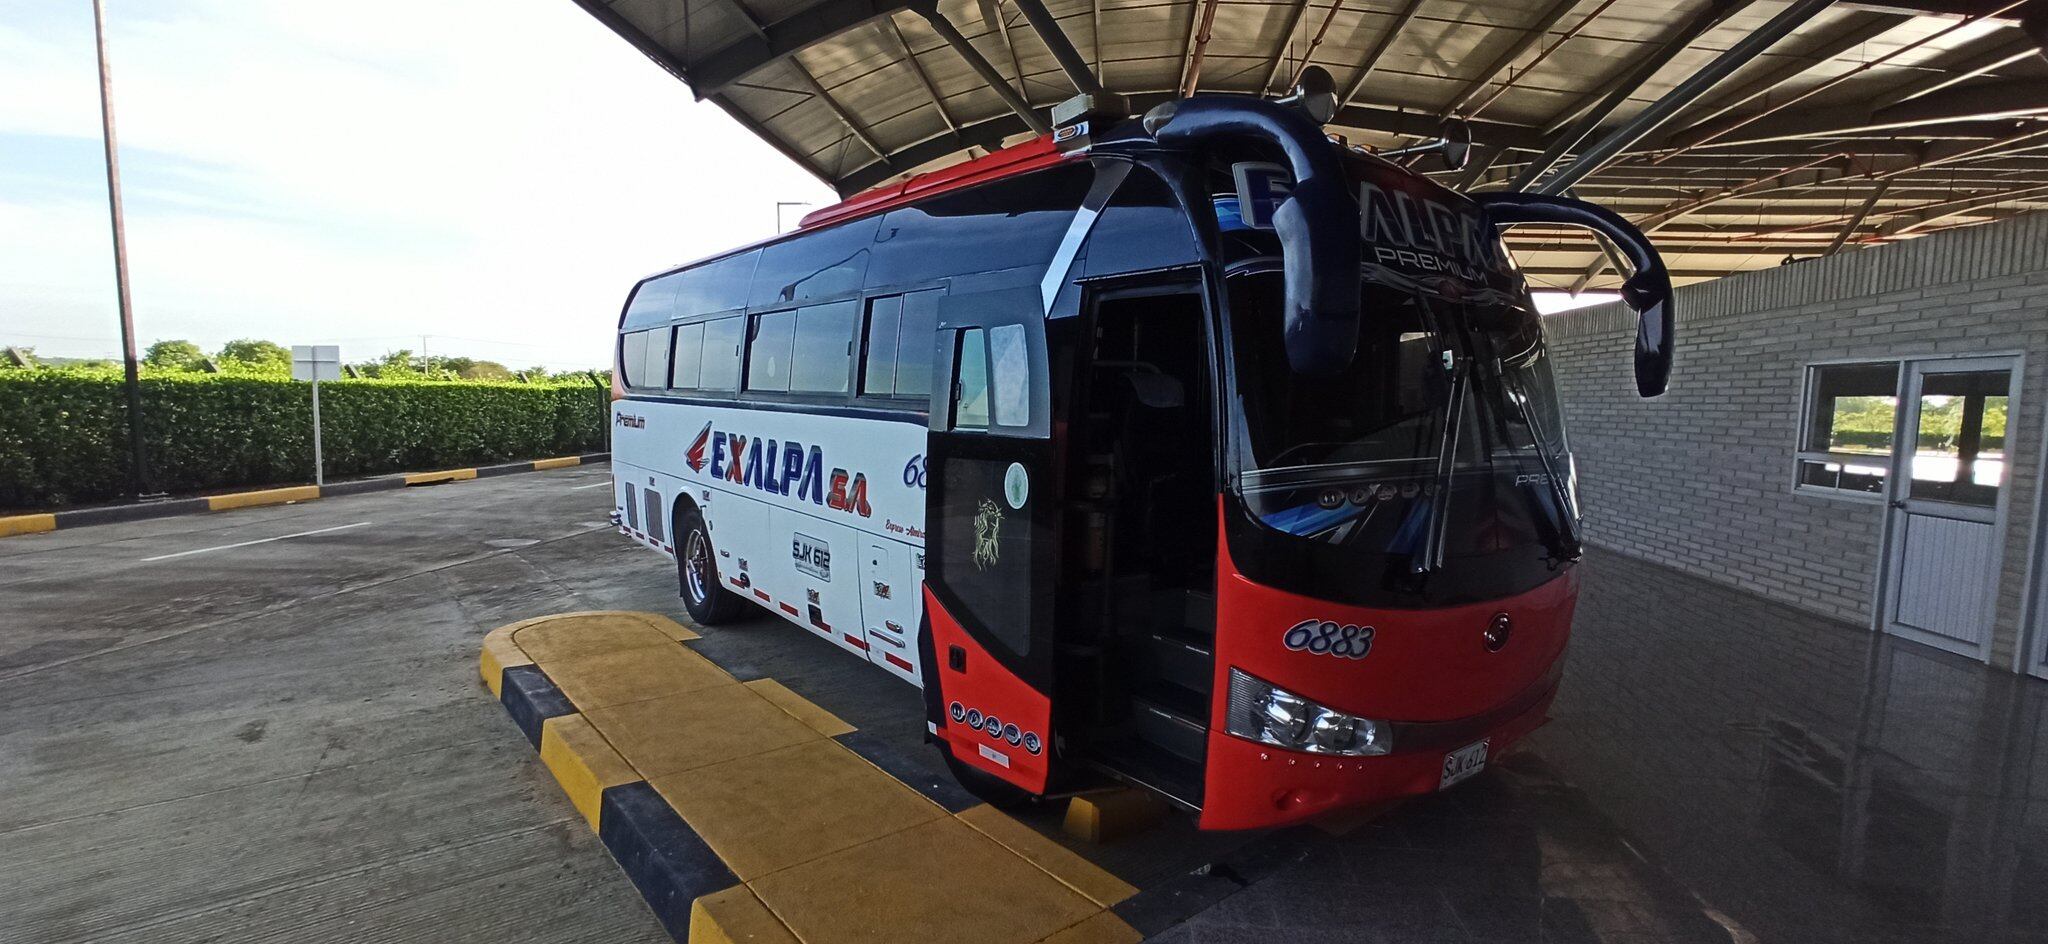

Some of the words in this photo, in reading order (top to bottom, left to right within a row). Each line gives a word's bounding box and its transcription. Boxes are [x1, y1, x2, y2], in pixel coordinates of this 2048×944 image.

[1231, 161, 1494, 273] EALPA
[1375, 246, 1488, 285] PREMIUM
[615, 411, 646, 430] Premium
[711, 431, 823, 504] EXALPA
[904, 454, 928, 489] 68
[792, 540, 812, 564] SJK
[814, 548, 831, 571] 612
[1284, 619, 1376, 660] 6883
